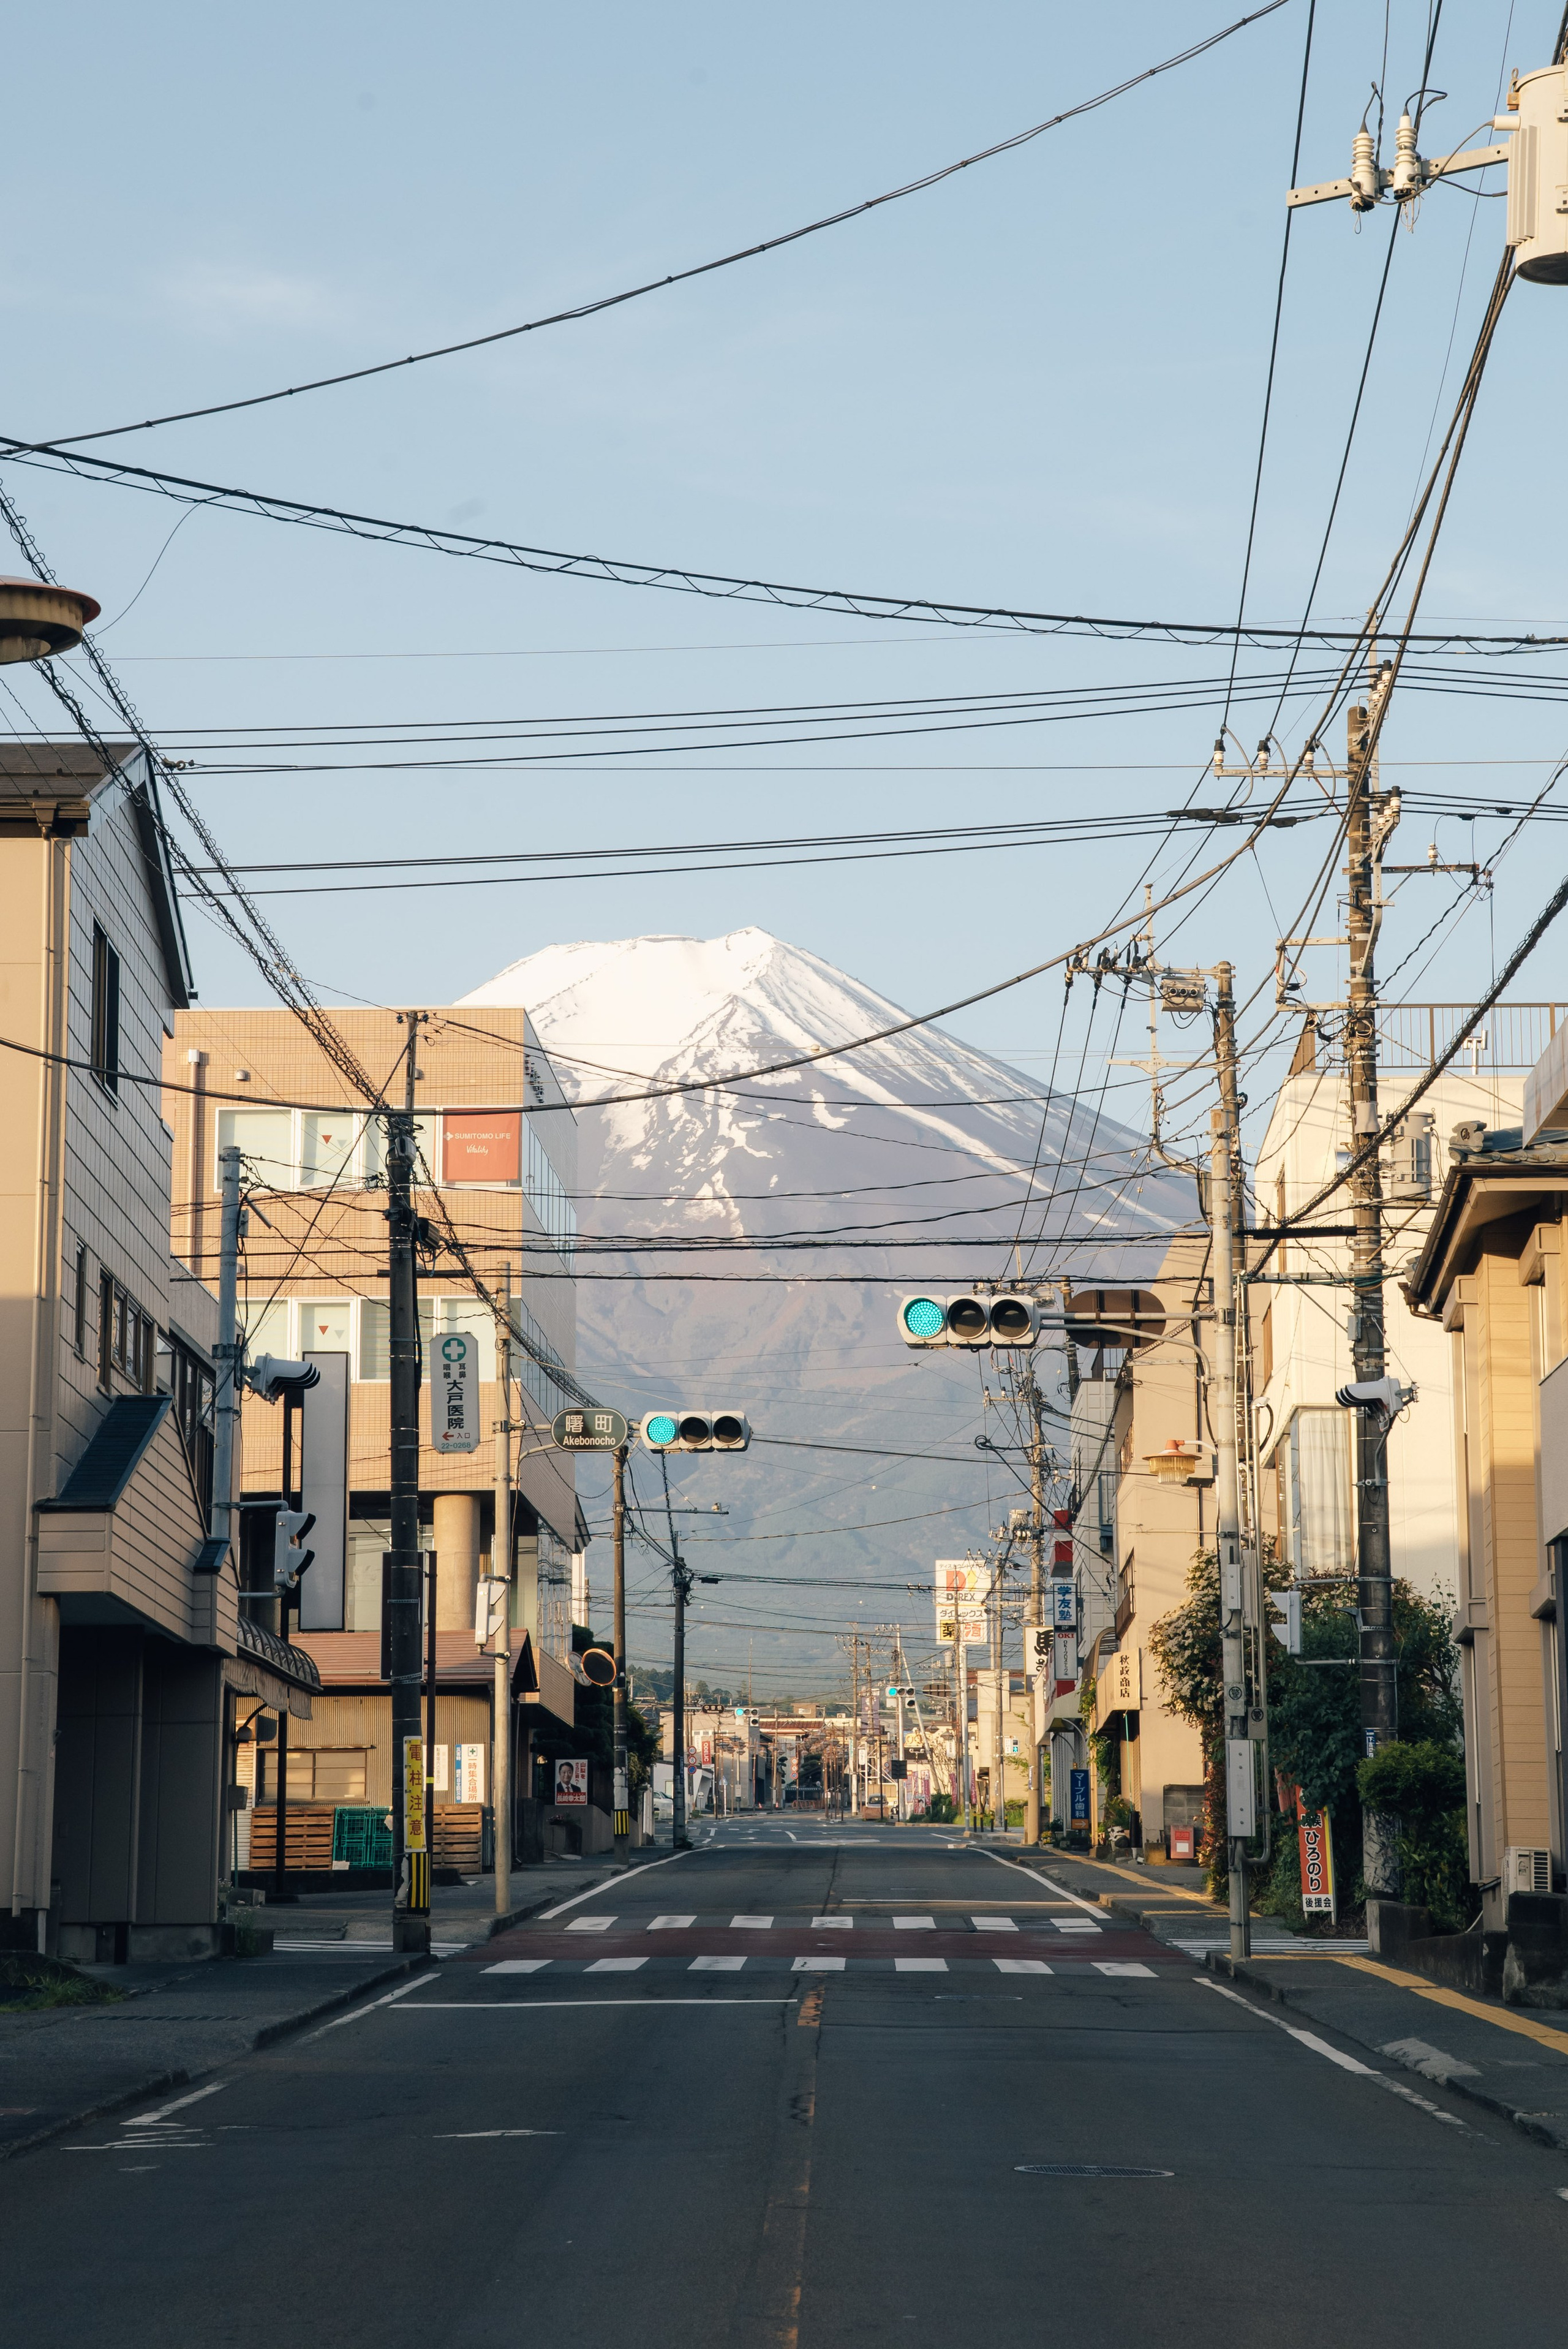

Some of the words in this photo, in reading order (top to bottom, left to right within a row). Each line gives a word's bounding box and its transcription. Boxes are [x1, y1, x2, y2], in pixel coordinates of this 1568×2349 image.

[467, 1144, 488, 1156] Vitality
[447, 1380, 464, 1429] 大戸医院
[566, 1415, 613, 1432] 曙町
[563, 1436, 616, 1445] Akebonocho
[1057, 1586, 1072, 1621] 学友塾
[965, 1623, 981, 1637] 酒
[1120, 1655, 1129, 1698] 秋政商店
[409, 1744, 422, 1836] 電柱注意
[468, 1758, 477, 1801] 一時集合場所
[1074, 1772, 1085, 1818] マーブル歯科
[1305, 1830, 1322, 1893] ひろのり
[1305, 1897, 1331, 1907] 後援会
